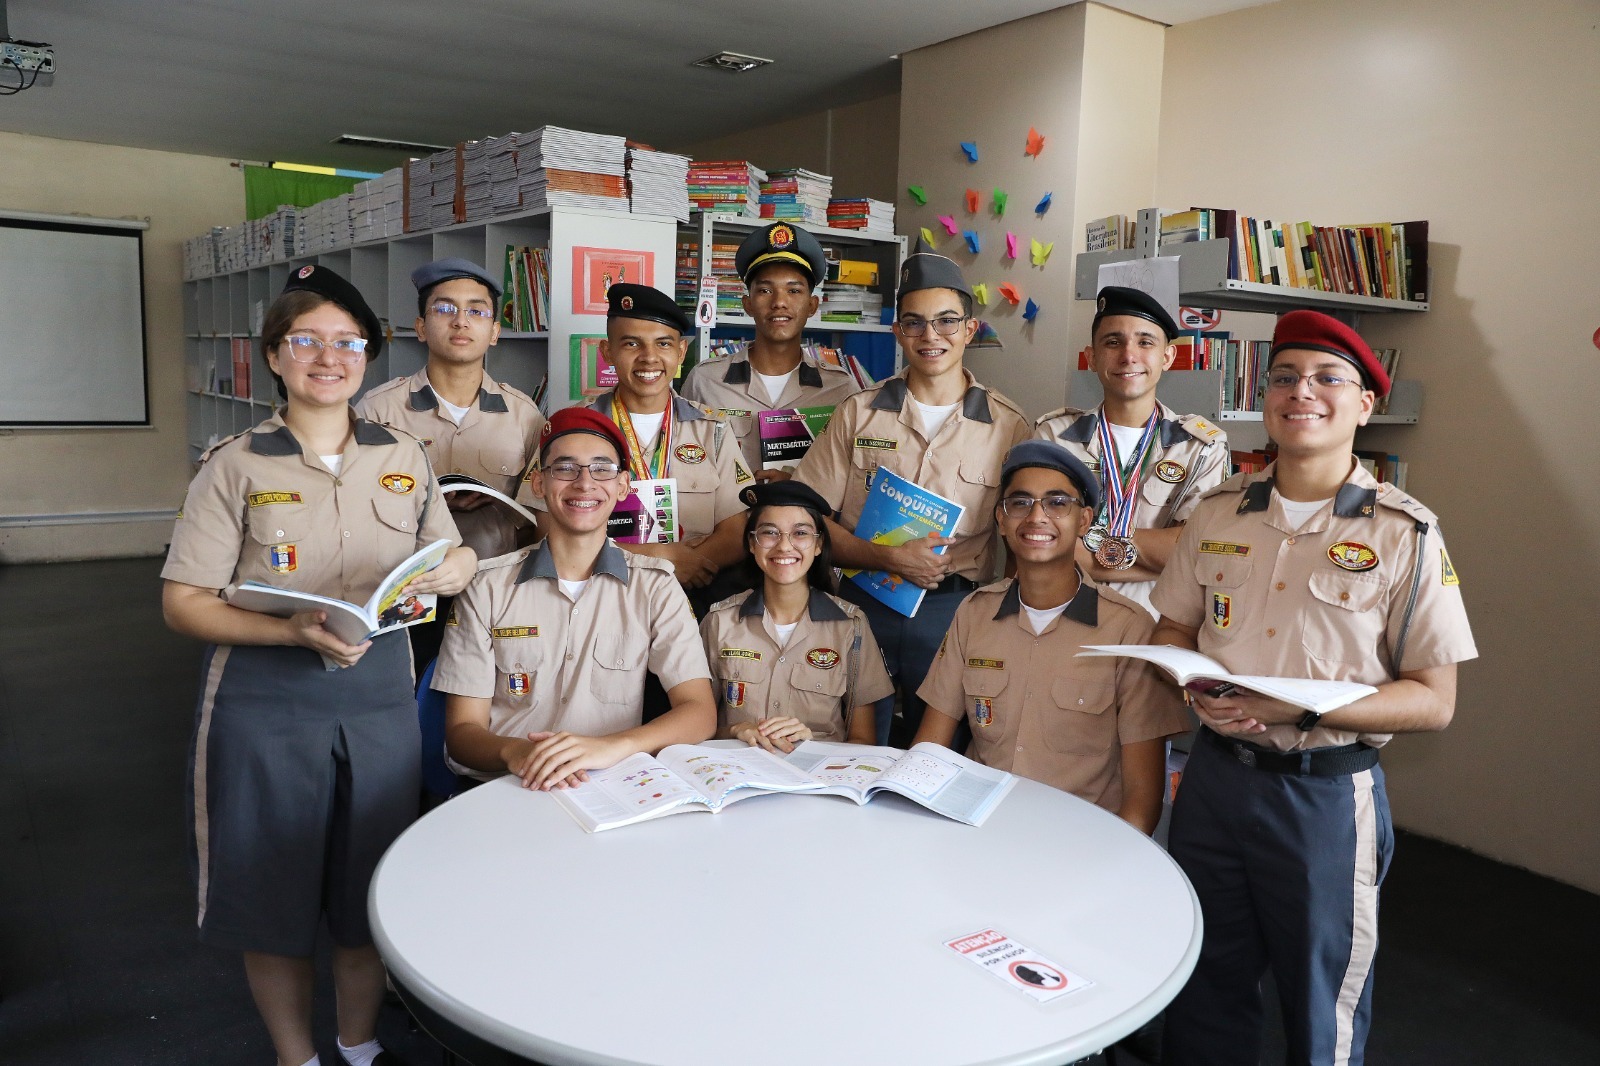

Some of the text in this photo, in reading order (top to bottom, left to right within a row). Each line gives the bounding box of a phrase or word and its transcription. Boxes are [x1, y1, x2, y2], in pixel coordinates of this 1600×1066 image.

[1087, 229, 1117, 242] Literatura
[1087, 238, 1117, 251] Brasileira
[766, 439, 813, 451] MATEMÁTICA
[880, 482, 948, 524] CONQUISTA
[907, 511, 943, 531] MATEMÁTICA
[953, 930, 1003, 953] ATENÇÃO
[976, 942, 1013, 958] SILÊNCIO
[983, 947, 1026, 966] POR FAVOR
